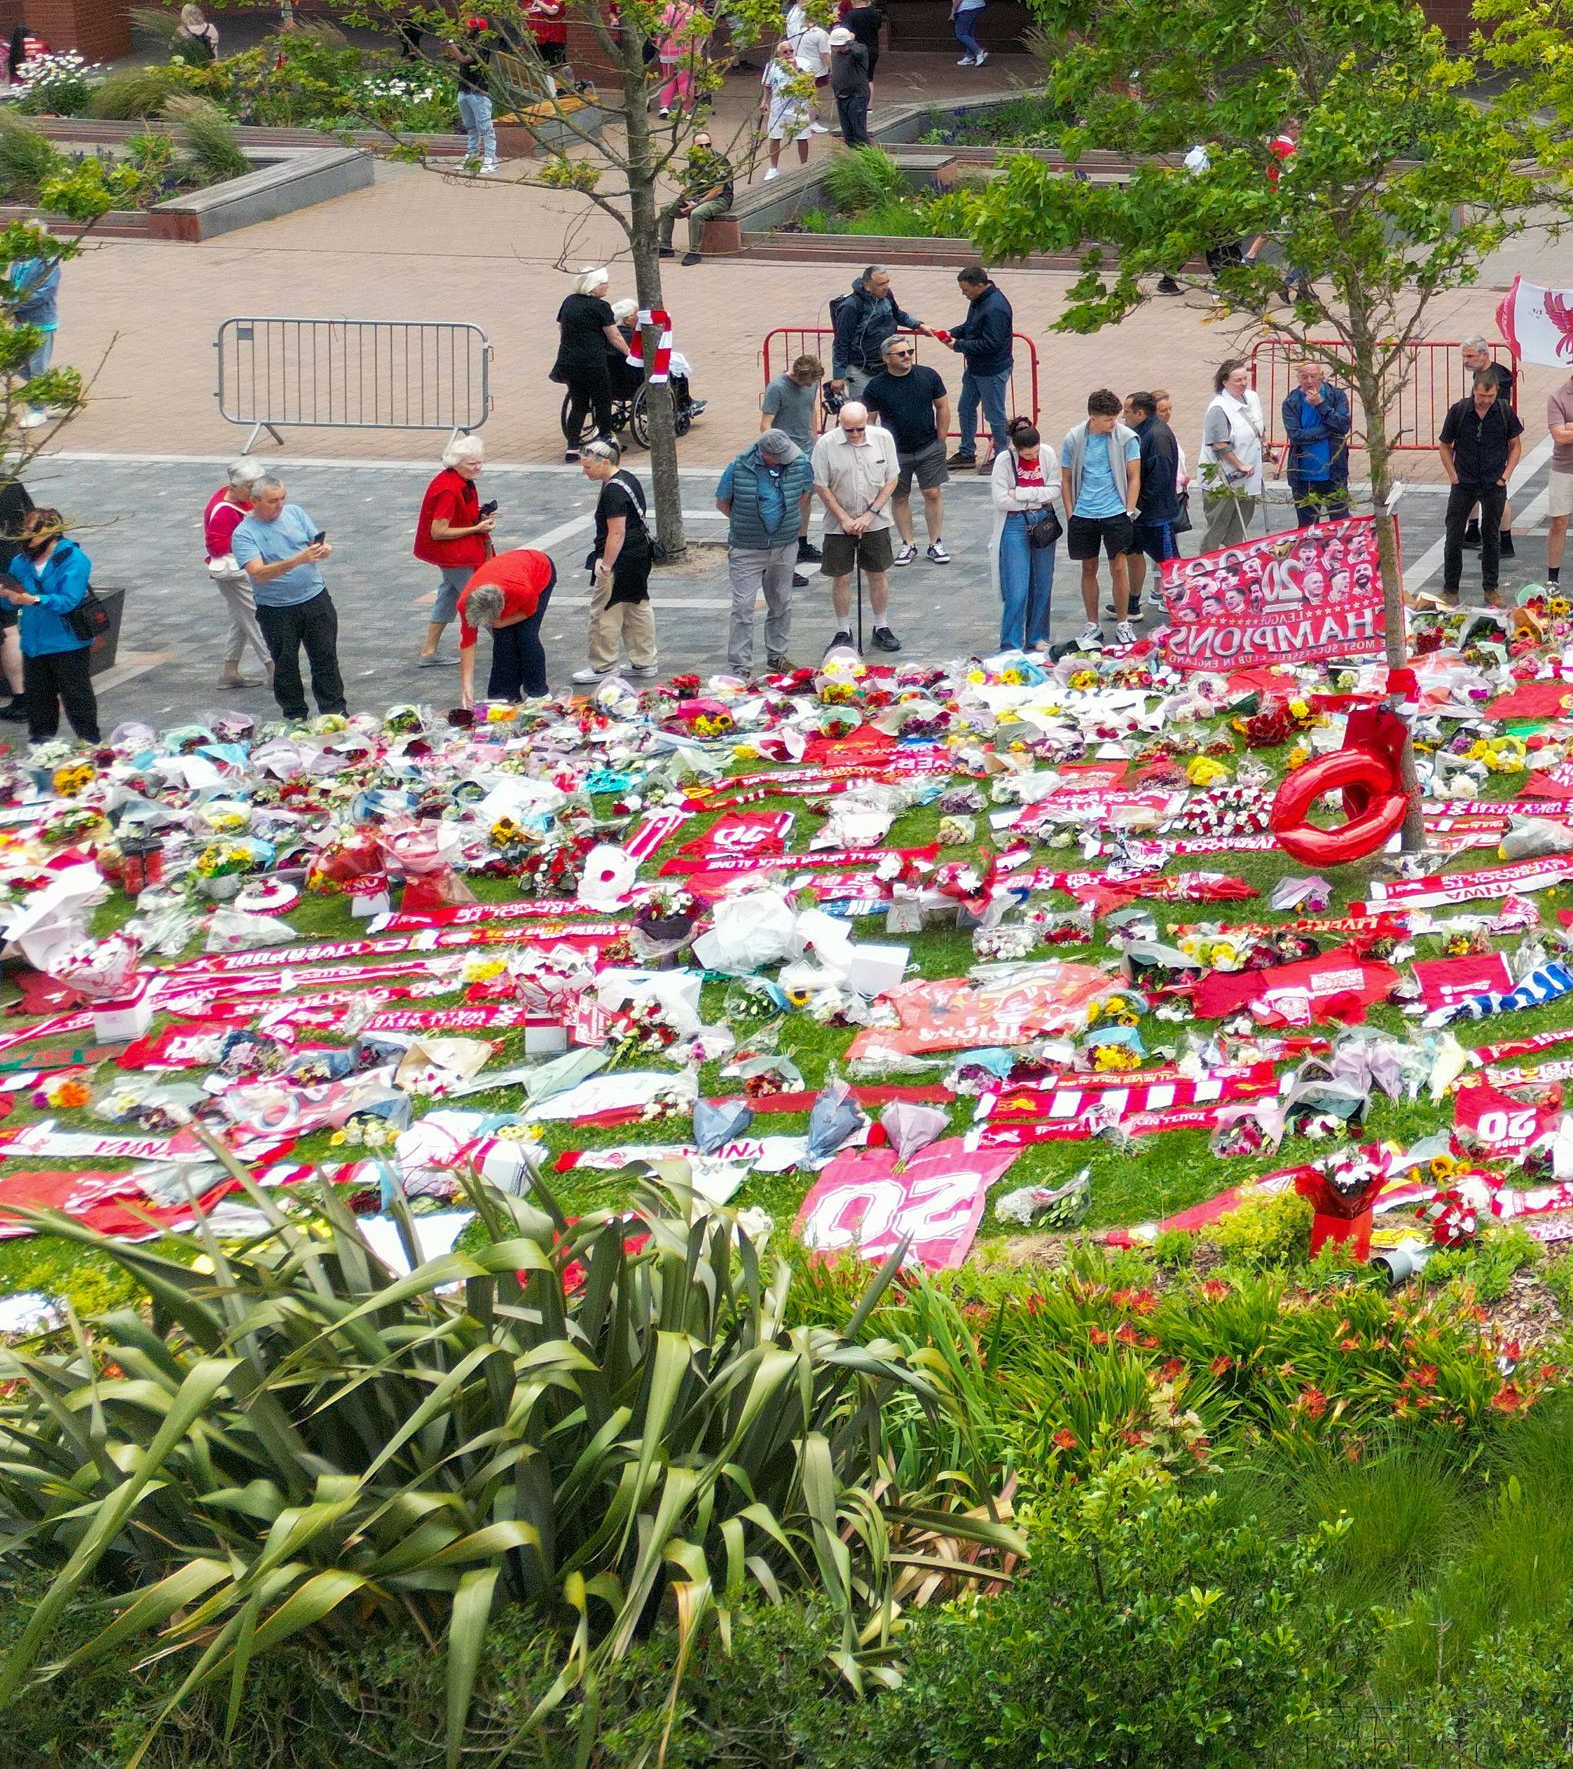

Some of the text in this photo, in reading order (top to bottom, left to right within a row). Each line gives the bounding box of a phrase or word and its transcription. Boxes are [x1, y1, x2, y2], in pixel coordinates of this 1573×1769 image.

[706, 858, 754, 871] ALONE
[757, 855, 798, 868] WALK
[1444, 882, 1519, 901] YNWA
[222, 937, 362, 973] LIVERPOOL
[1477, 1109, 1537, 1141] 20
[681, 1141, 765, 1163] YNA
[803, 1173, 983, 1250] 20
